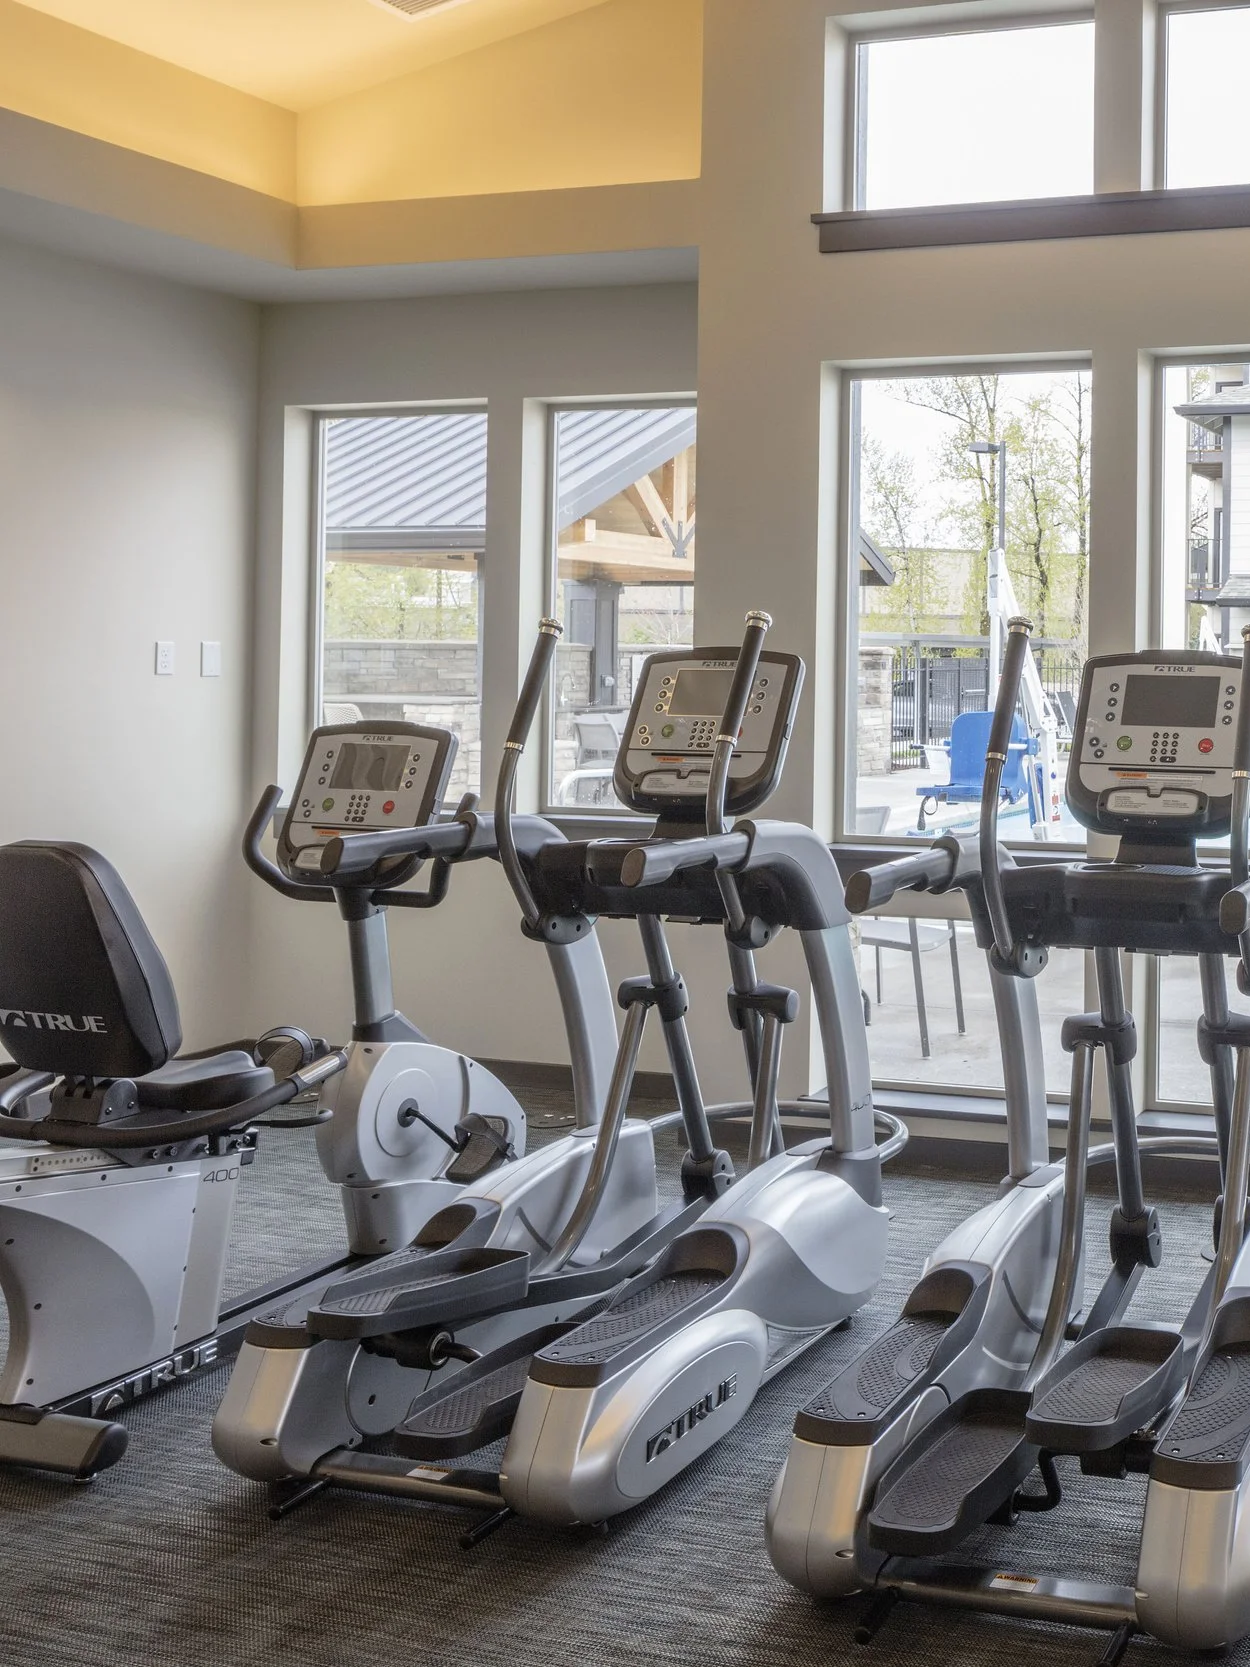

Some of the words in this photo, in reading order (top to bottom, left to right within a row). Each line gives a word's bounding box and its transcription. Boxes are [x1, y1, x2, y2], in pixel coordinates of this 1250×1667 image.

[1166, 665, 1196, 673] TRUE
[24, 1010, 108, 1033] TRUE
[202, 1167, 240, 1184] 400
[125, 1338, 218, 1399] TRUE
[673, 1372, 737, 1438] TRUE
[1003, 1574, 1038, 1585] WARNING
